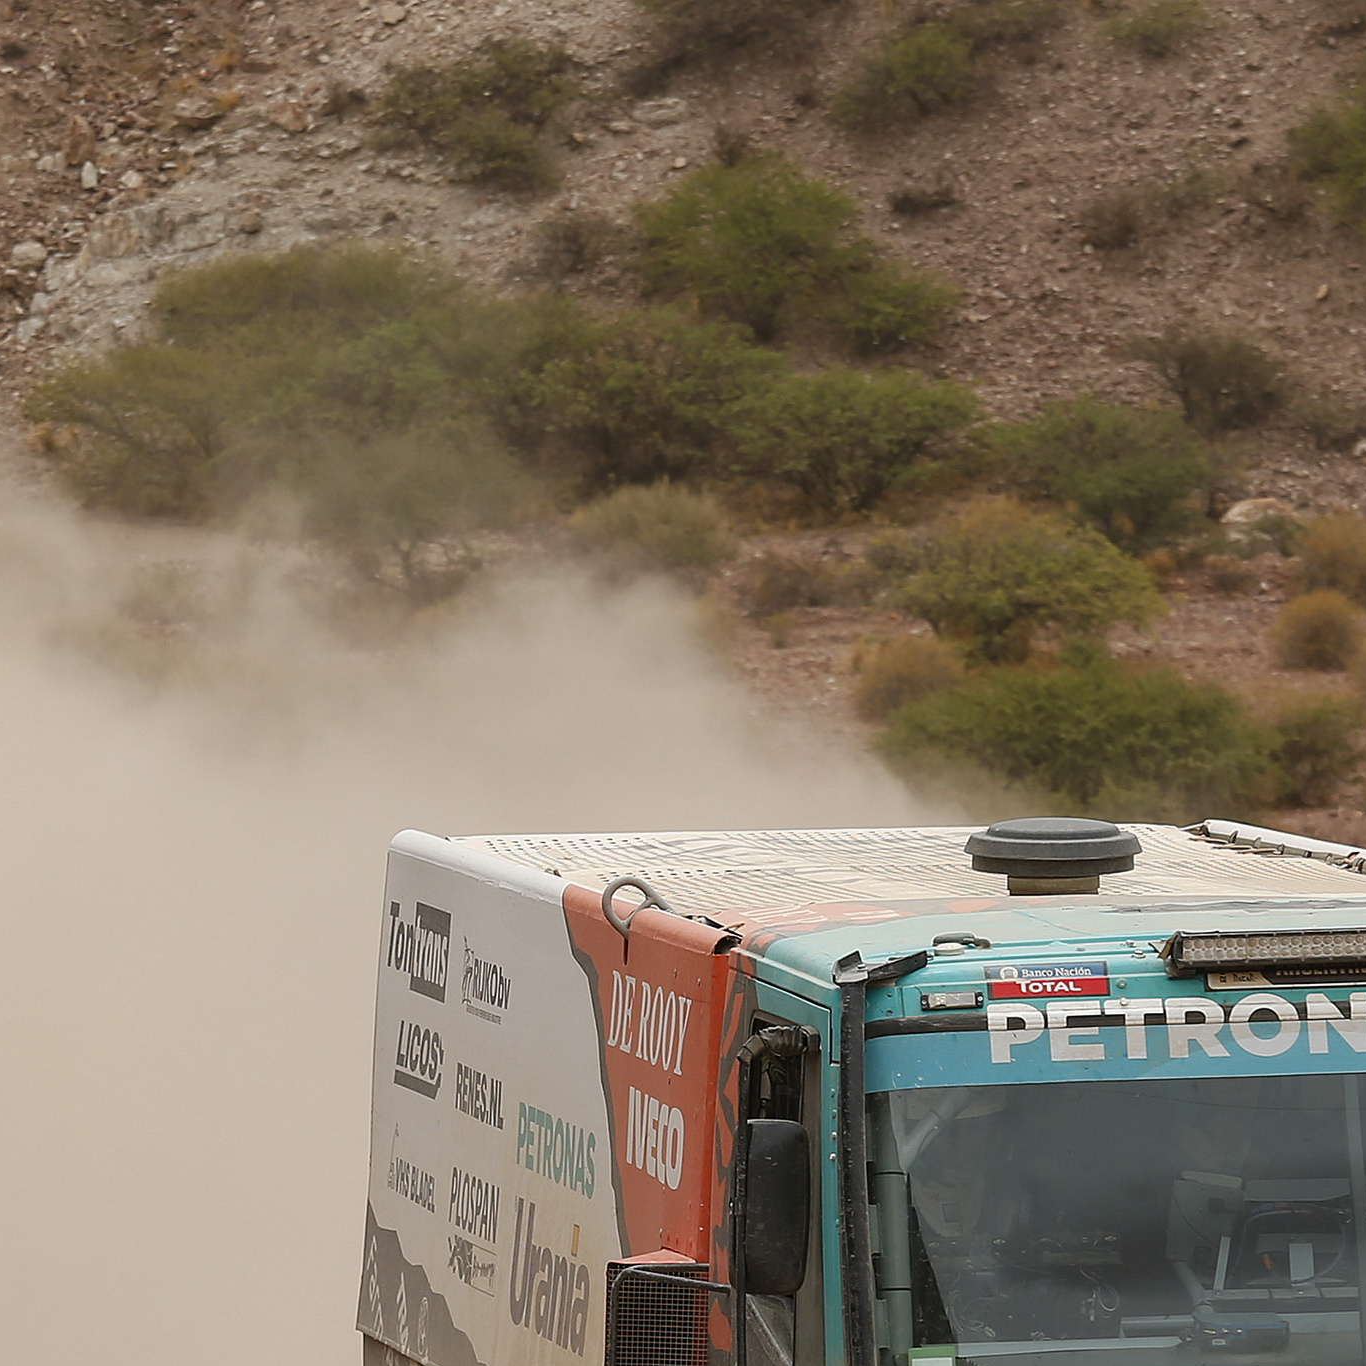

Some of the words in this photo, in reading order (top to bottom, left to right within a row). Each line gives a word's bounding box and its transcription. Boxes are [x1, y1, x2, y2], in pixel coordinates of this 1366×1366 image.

[1016, 980, 1082, 993] TOTAL
[1021, 968, 1054, 978] Banco
[1054, 966, 1092, 977] Nación
[395, 1020, 443, 1082] LICOS
[607, 970, 636, 1053] DE
[636, 981, 692, 1075] ROOY
[516, 1101, 596, 1200] PETRONAS
[626, 1086, 684, 1190] IVECO
[448, 1166, 500, 1244] PLOSPAN
[510, 1197, 590, 1358] Urania
